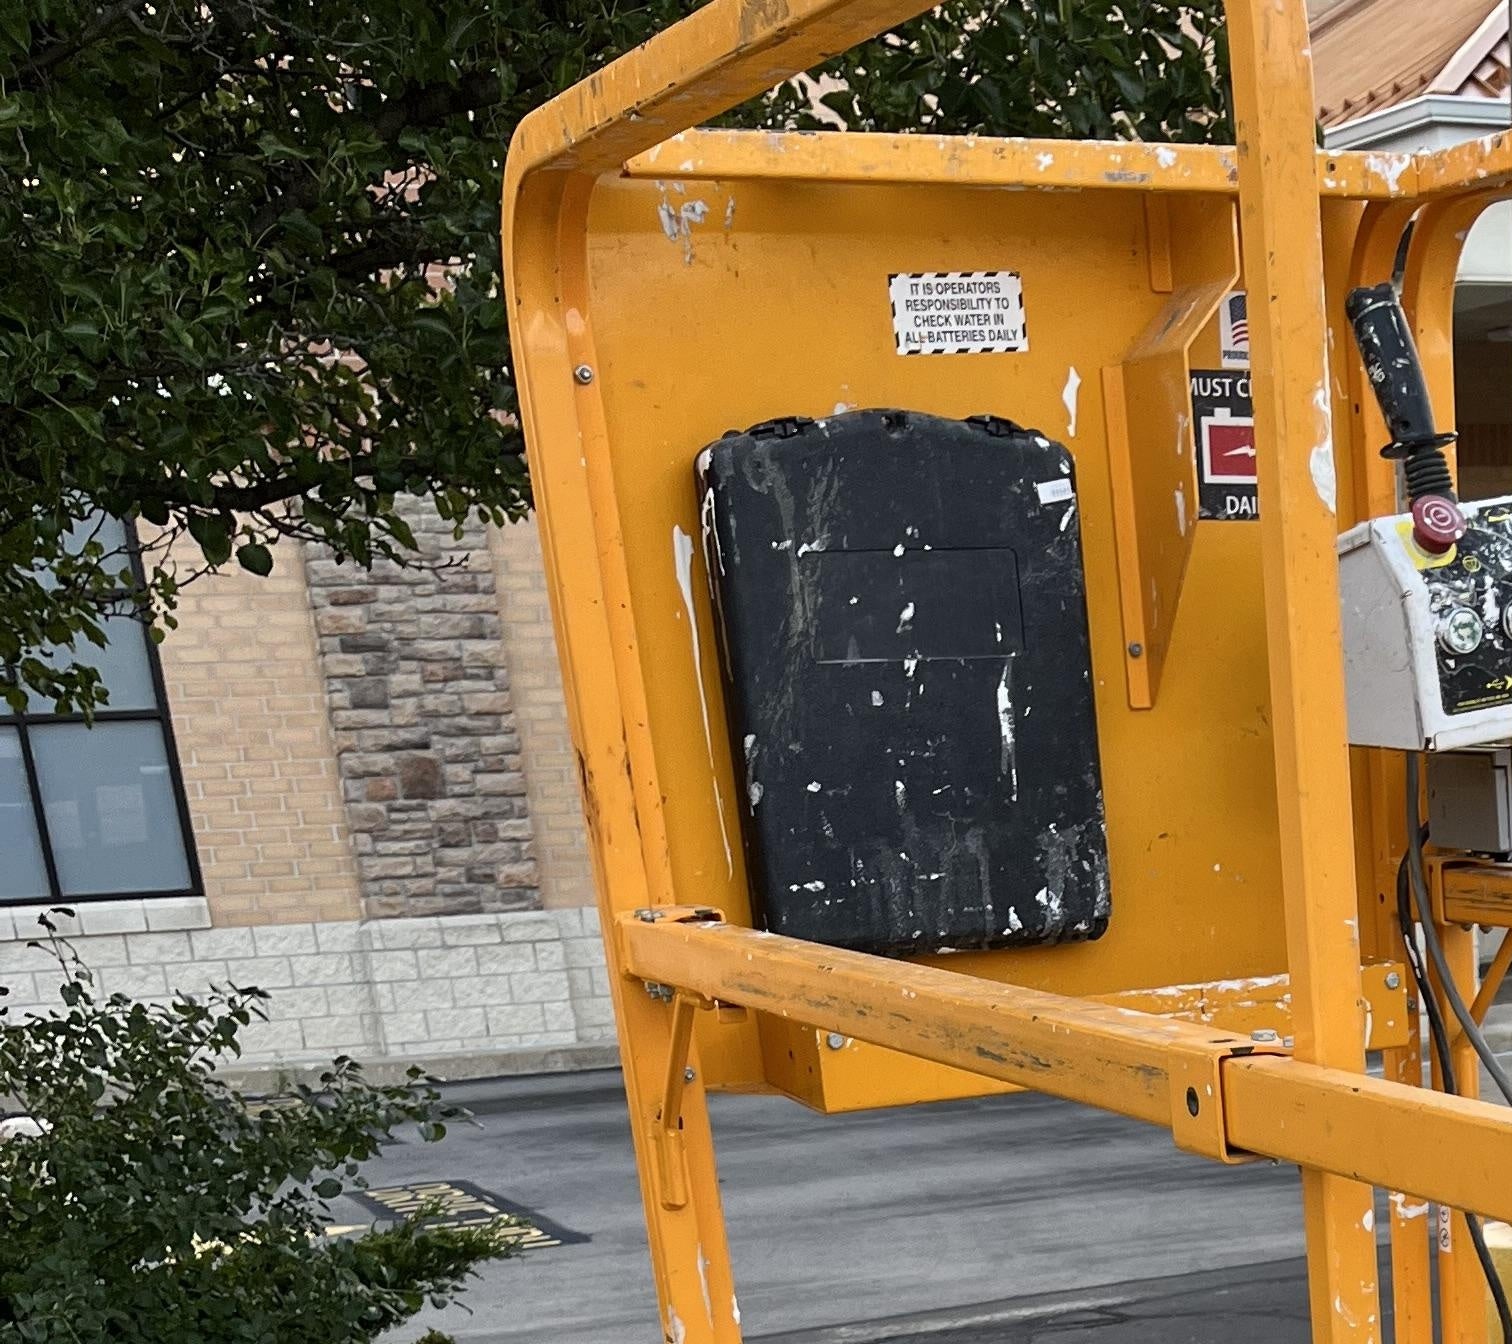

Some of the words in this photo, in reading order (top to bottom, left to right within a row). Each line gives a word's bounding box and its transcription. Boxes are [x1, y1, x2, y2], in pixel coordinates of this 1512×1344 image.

[910, 283, 919, 295] IT
[923, 283, 933, 295] IS
[935, 282, 1001, 295] OPERATORS
[905, 298, 992, 311] RESPONSIBILITY
[994, 297, 1009, 310] TO
[914, 314, 952, 327] CHECK
[954, 314, 991, 326] WATER
[993, 314, 1004, 325] IN
[927, 330, 986, 343] BATTERIES
[988, 329, 1018, 341] DAILY
